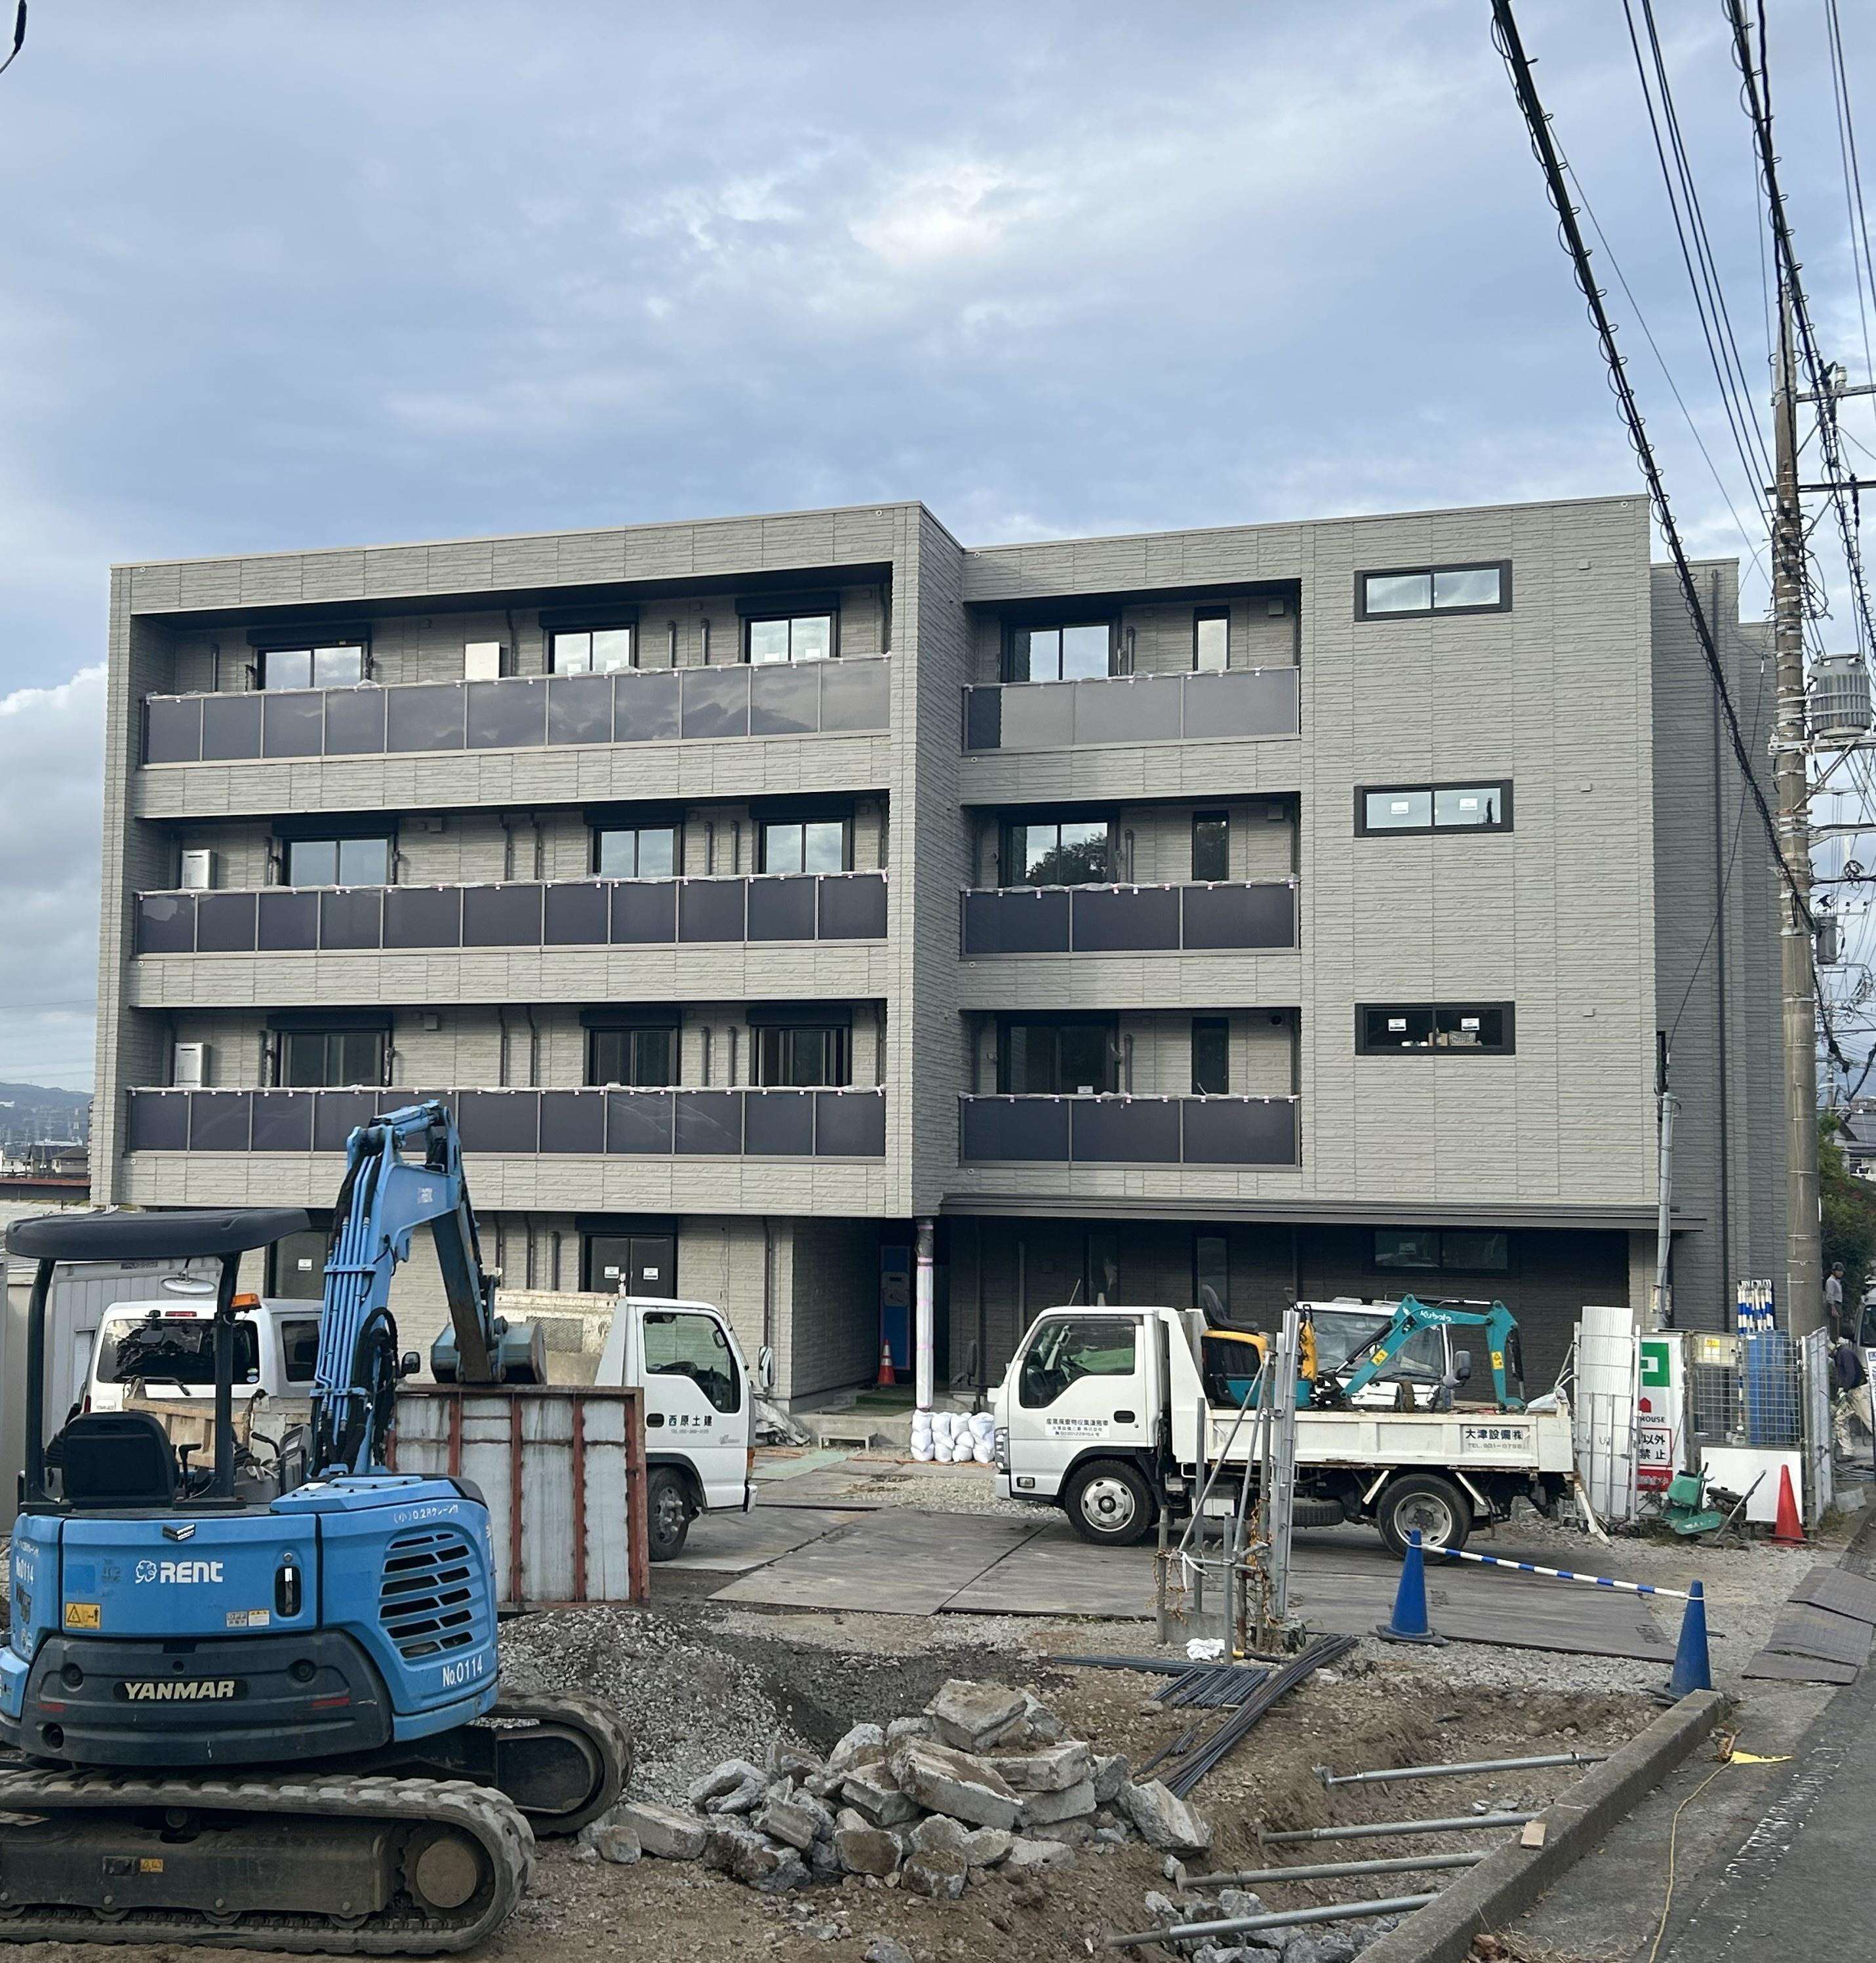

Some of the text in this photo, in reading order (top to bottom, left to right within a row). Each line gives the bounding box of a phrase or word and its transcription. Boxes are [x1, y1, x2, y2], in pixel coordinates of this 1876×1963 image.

[1420, 1311, 1452, 1322] Kubota
[669, 1416, 712, 1426] 西原土建
[443, 1654, 483, 1687] No.0114
[125, 1680, 235, 1699] YANMAR
